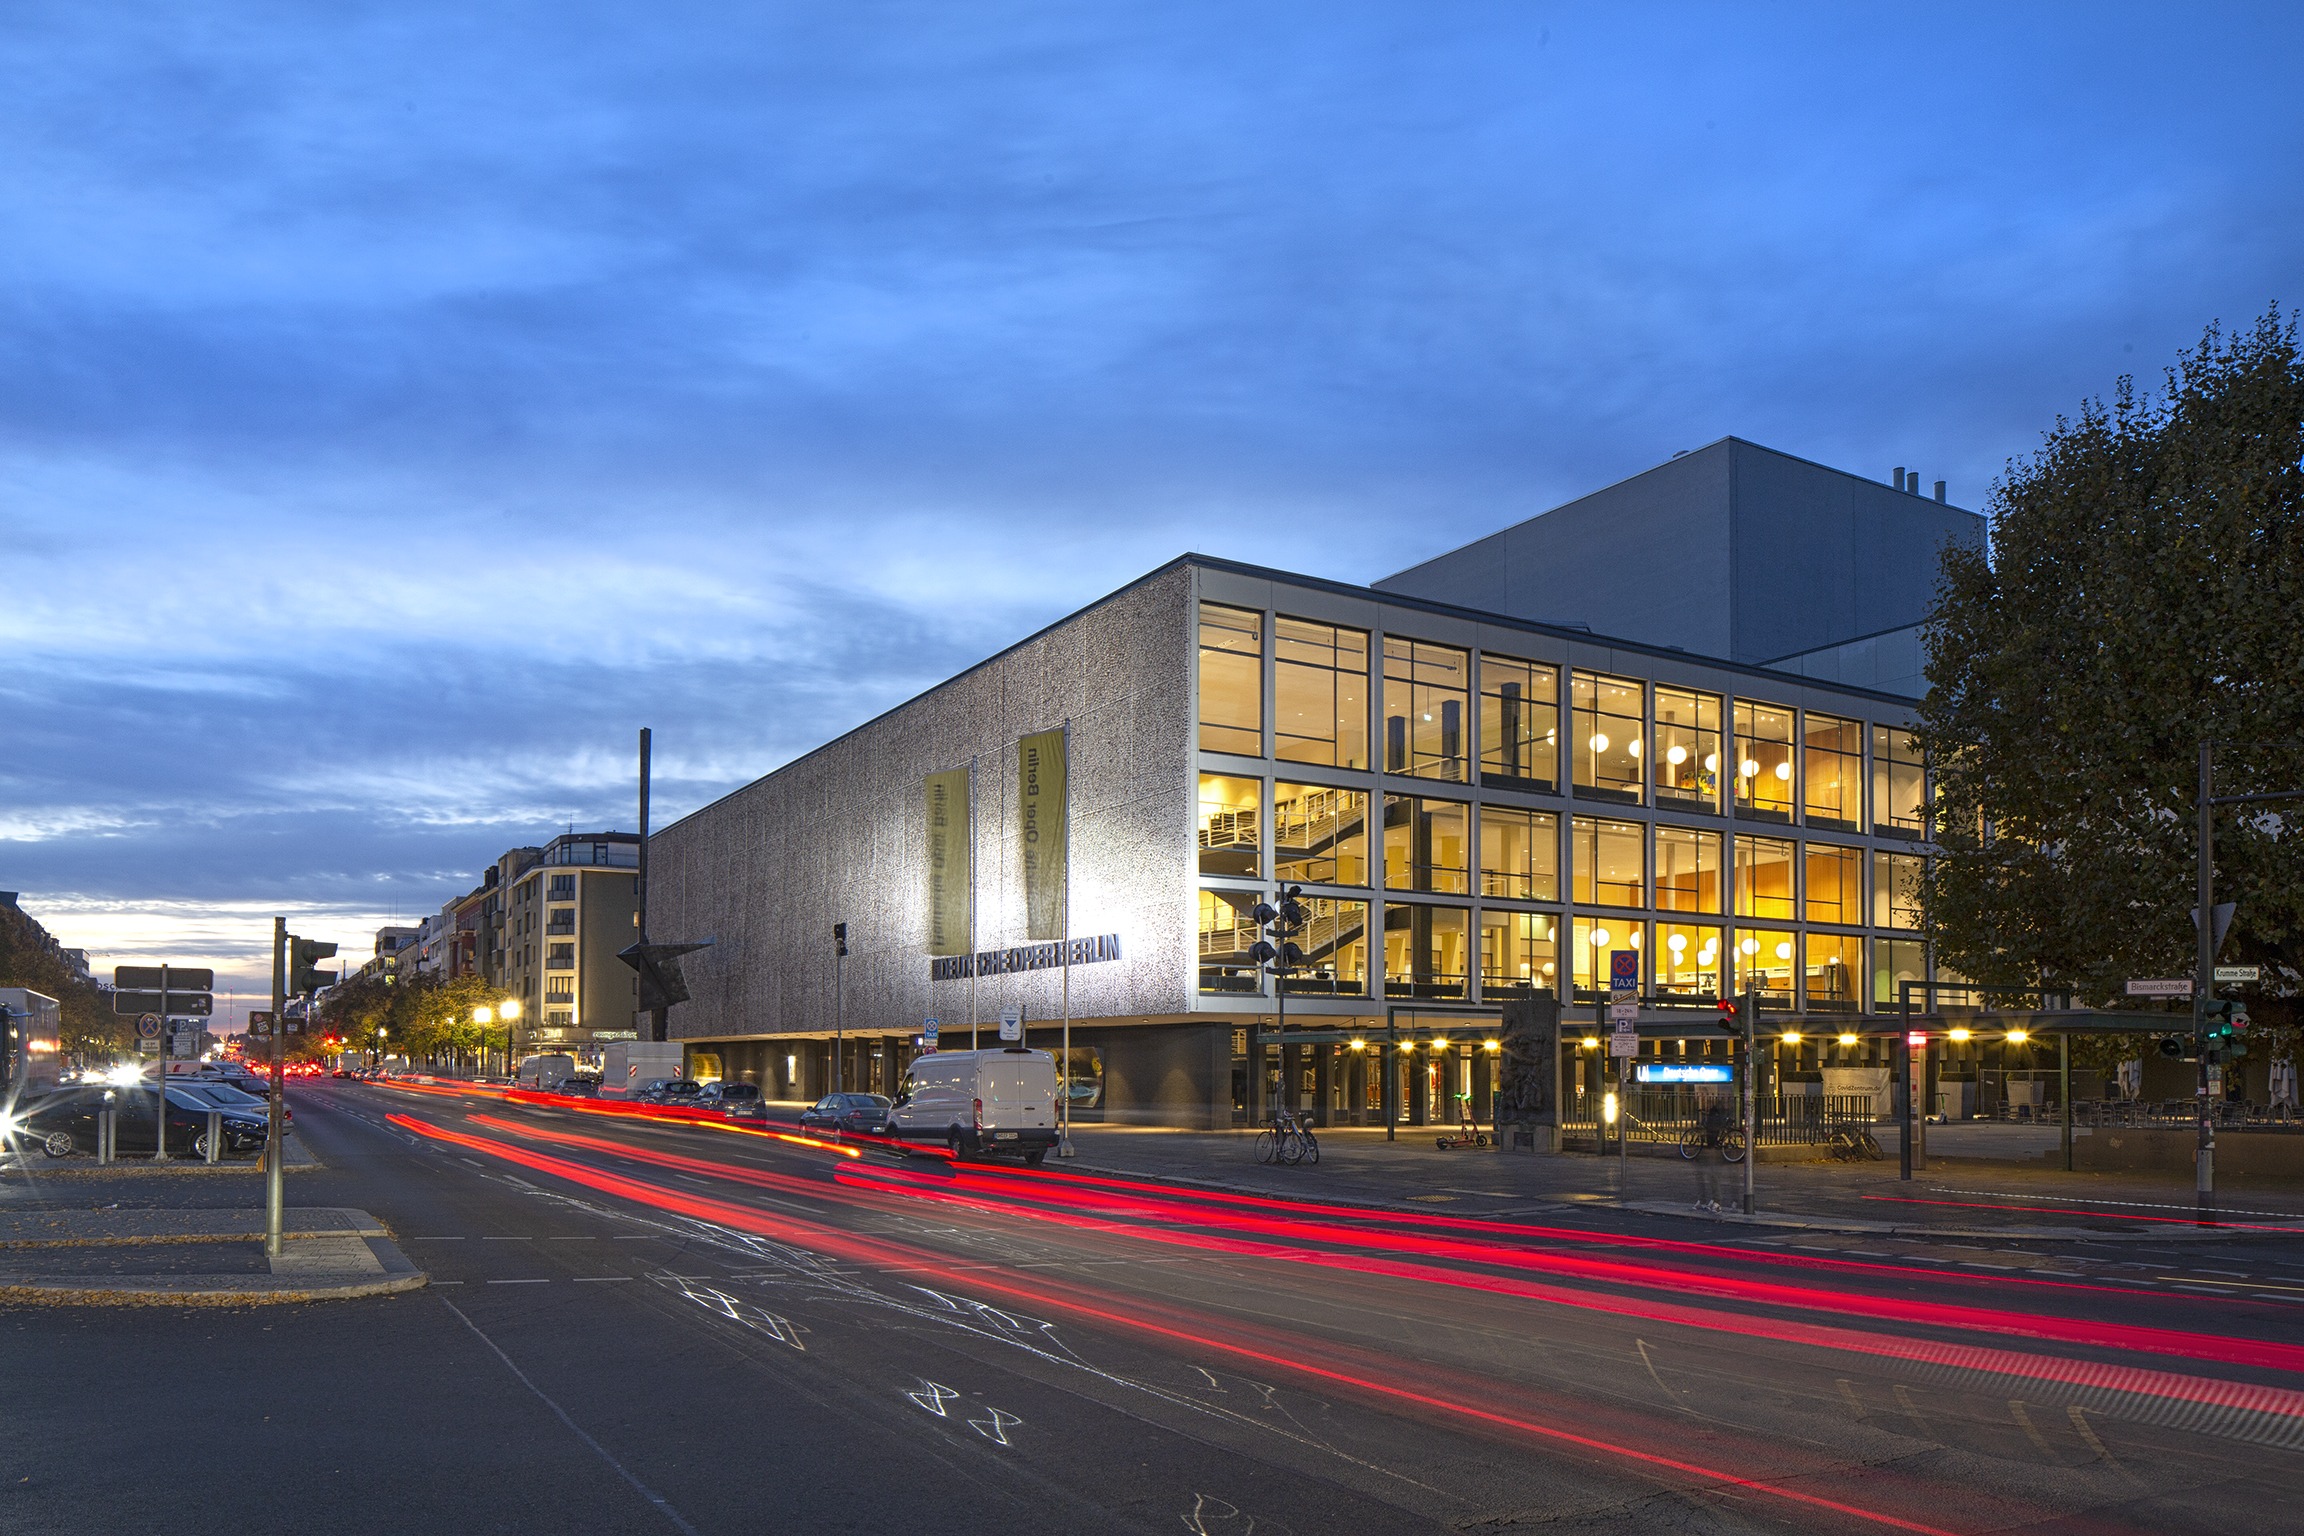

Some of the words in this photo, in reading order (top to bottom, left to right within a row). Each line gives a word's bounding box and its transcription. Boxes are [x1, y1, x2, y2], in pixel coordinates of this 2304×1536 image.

[939, 949, 1011, 980] DEUTCHE
[1012, 943, 1055, 972] OPER
[1057, 934, 1121, 966] BERLIN
[2216, 968, 2238, 977] Krumme
[1613, 978, 1636, 988] TAXI
[2131, 982, 2188, 992] Bismarckstraße
